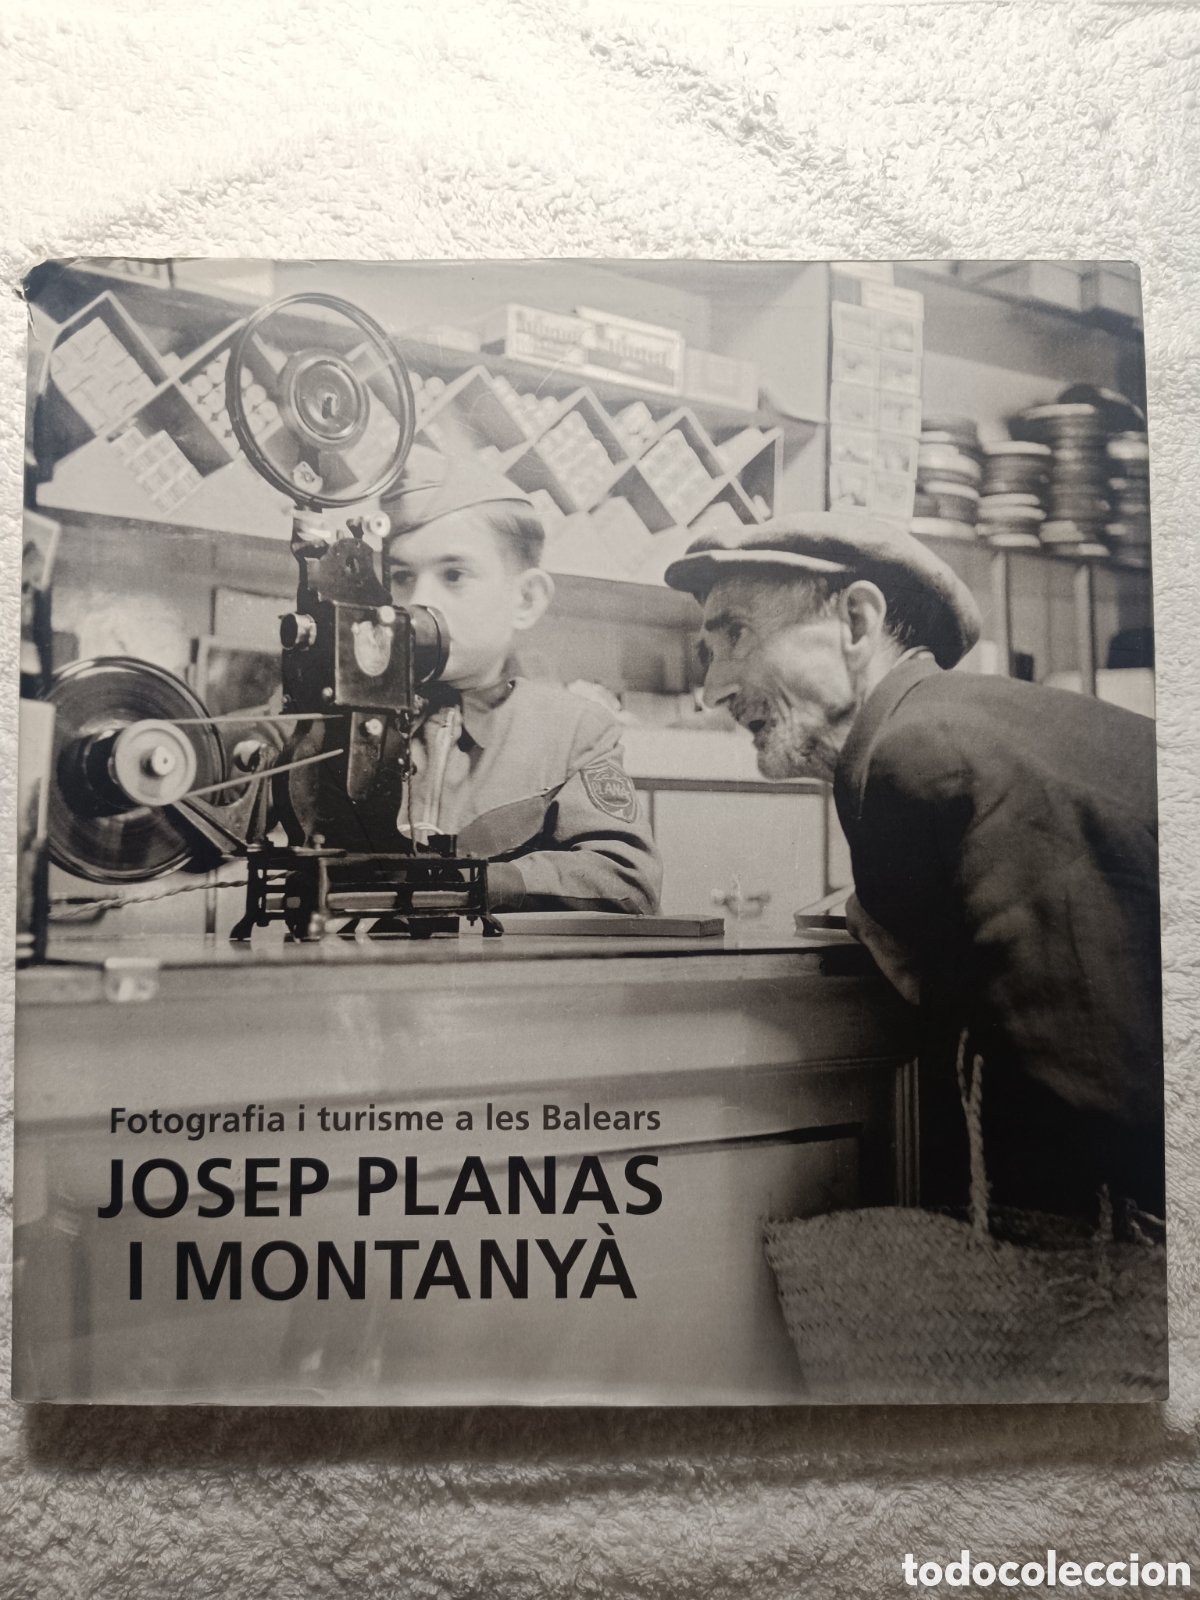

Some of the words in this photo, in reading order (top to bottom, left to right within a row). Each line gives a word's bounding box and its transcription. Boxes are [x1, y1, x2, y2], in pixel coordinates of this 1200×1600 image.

[110, 1104, 285, 1141] Fotografia
[298, 1104, 305, 1132] i
[317, 1104, 444, 1132] turisme
[455, 1110, 473, 1131] a
[486, 1103, 530, 1131] les
[544, 1103, 661, 1131] Balears
[98, 1157, 329, 1218] JOSEP
[358, 1155, 663, 1216] PLANAS
[129, 1241, 143, 1300] I
[176, 1223, 638, 1300] MONTANYÀ
